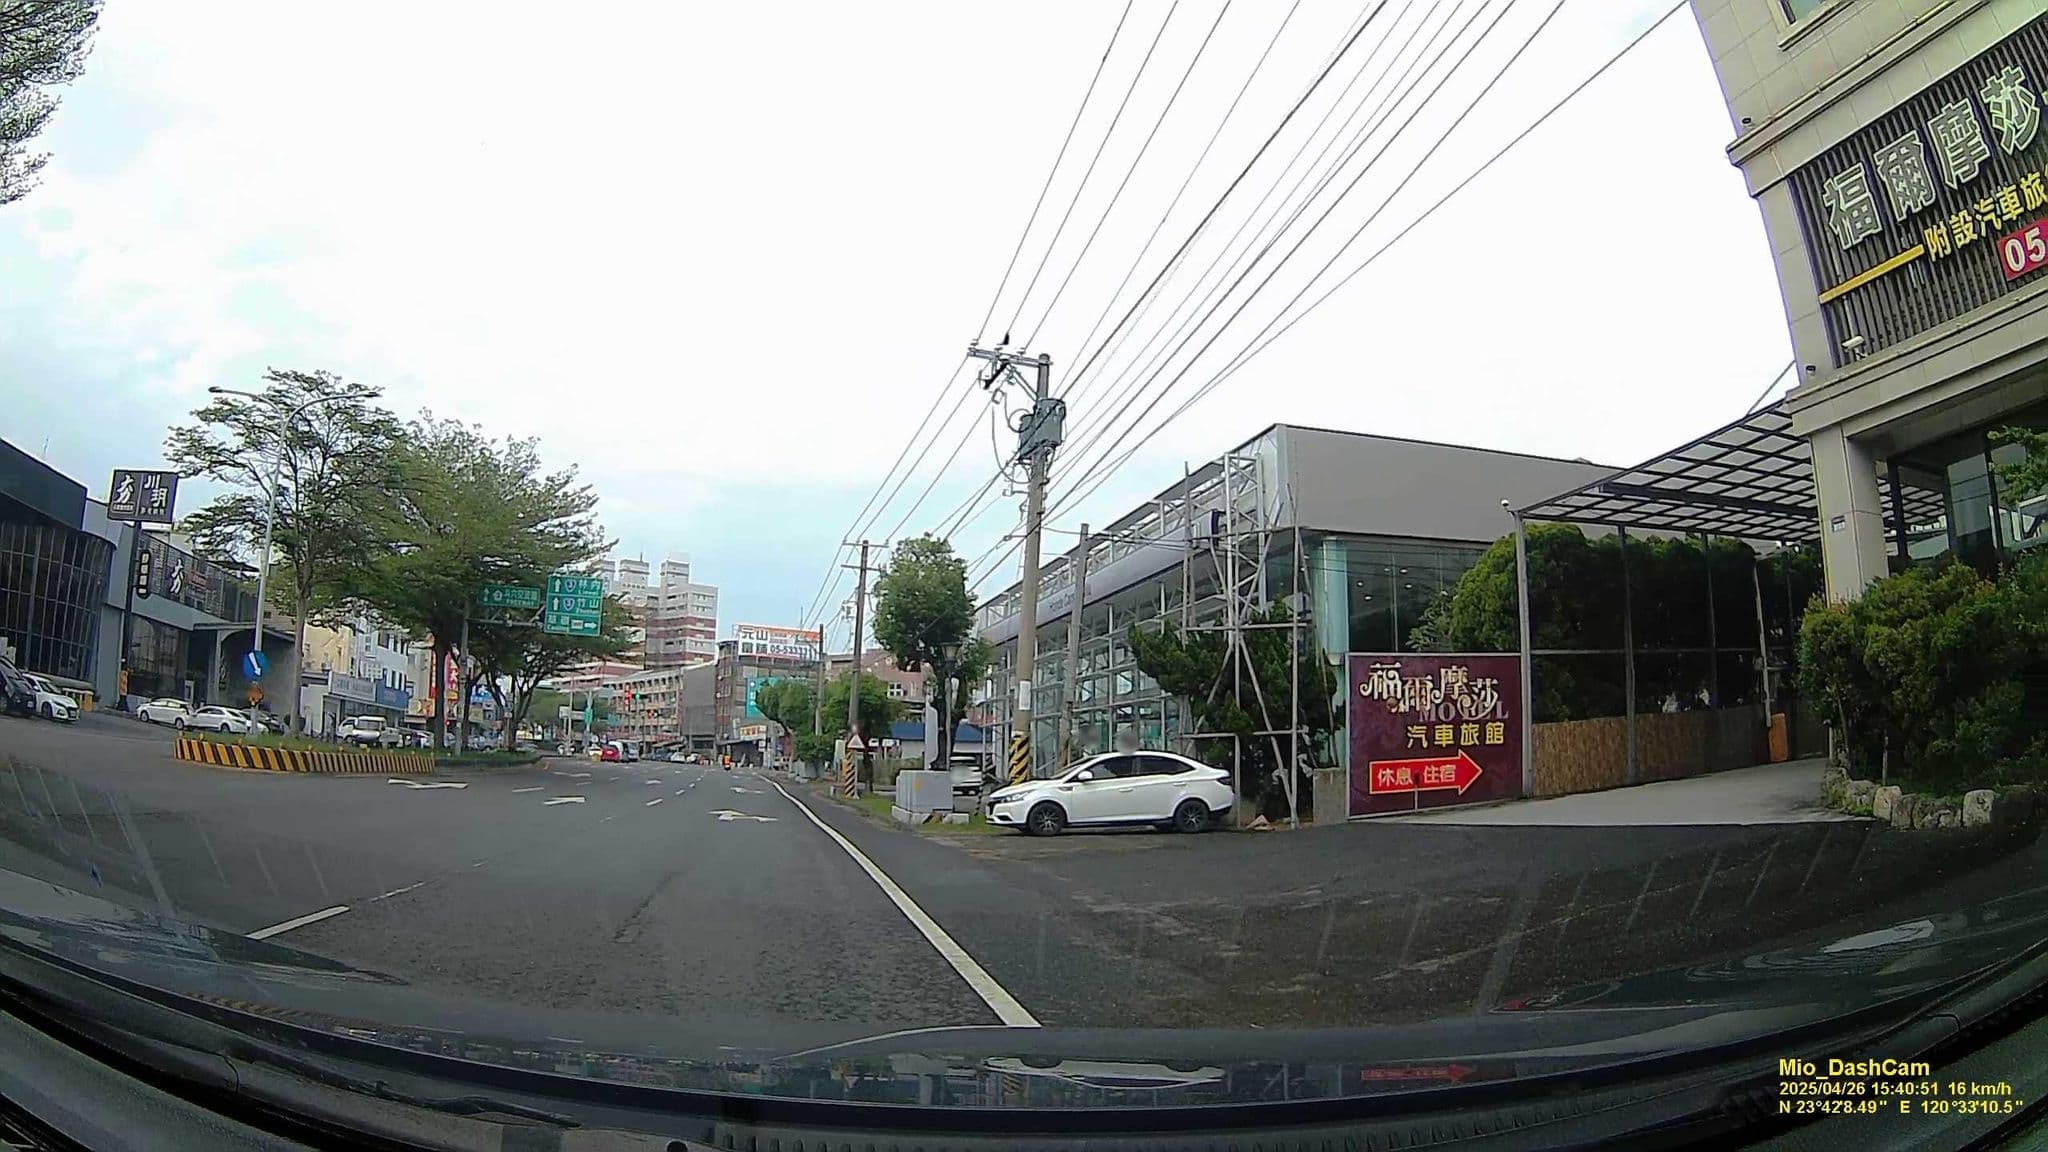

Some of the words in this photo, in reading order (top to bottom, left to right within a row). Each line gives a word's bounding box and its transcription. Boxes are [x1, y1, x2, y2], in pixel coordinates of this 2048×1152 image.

[1822, 65, 2048, 250] 福爾摩莎
[1924, 164, 2048, 262] 附設汽車旅
[2004, 227, 2047, 272] 05
[1360, 662, 1498, 720] 福爾摩莎
[1407, 722, 1505, 748] 汽車旅館
[1377, 767, 1413, 787] 休息
[1423, 764, 1456, 784] 住宿
